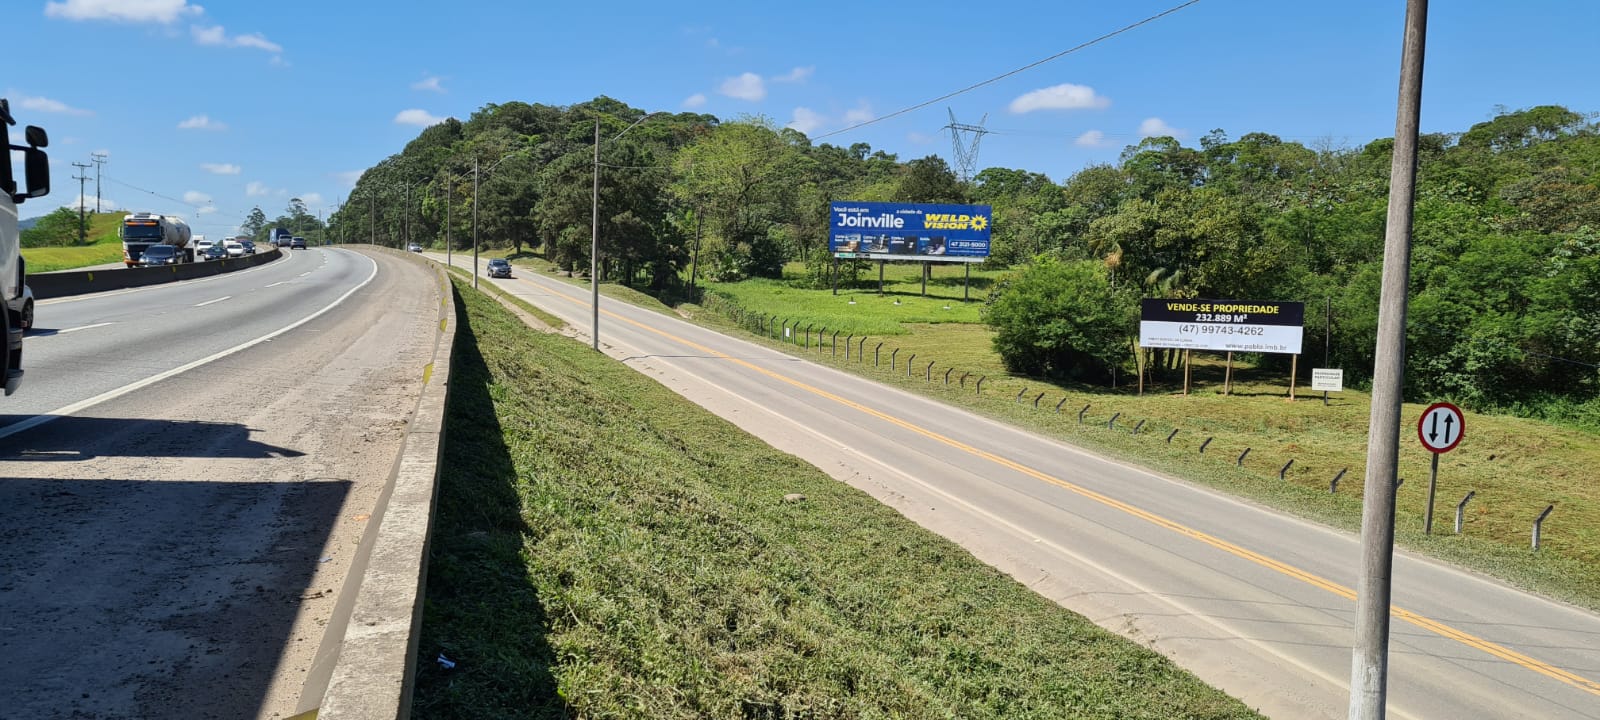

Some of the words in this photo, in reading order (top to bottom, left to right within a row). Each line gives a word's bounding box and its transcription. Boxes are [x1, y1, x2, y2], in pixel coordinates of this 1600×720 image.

[838, 213, 904, 228] Joinville
[925, 214, 970, 222] WELD
[1167, 303, 1210, 312] VENDE-SE
[1214, 304, 1279, 314] PROPRIEDADE
[1196, 314, 1231, 322] 232.889
[1179, 325, 1198, 334] (47)
[1202, 326, 1263, 335] 99743-4262
